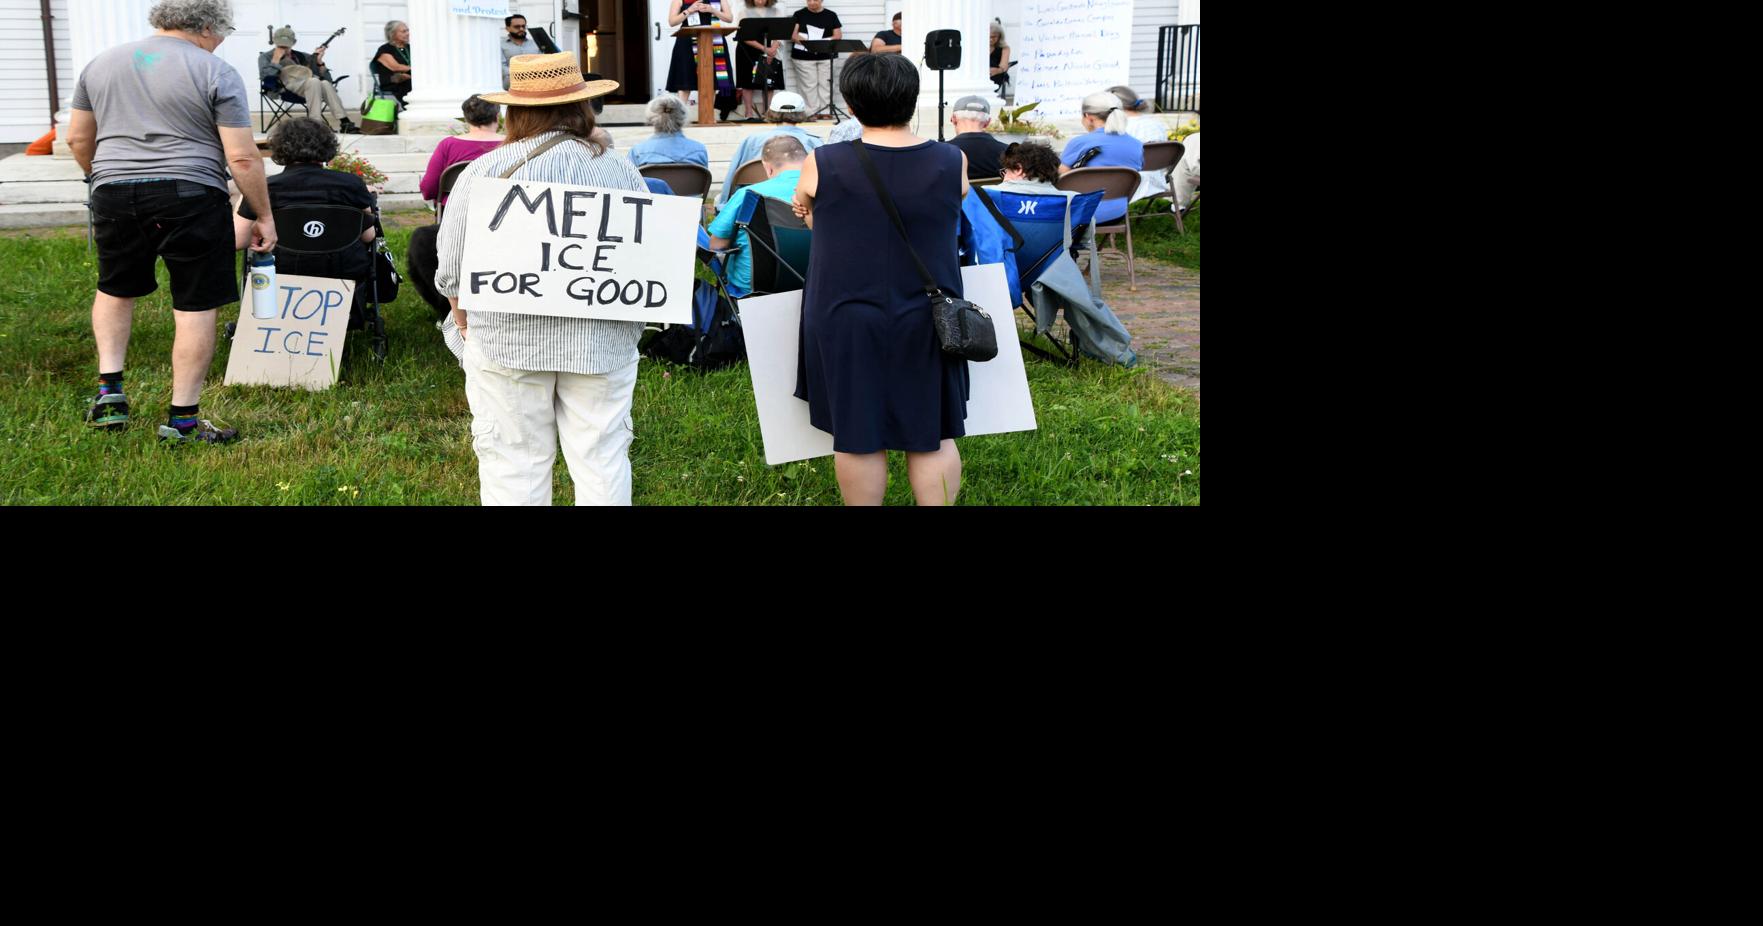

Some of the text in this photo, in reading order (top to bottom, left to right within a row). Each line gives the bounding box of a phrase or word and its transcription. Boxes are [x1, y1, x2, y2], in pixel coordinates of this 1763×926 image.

[472, 5, 507, 16] Protest
[488, 184, 653, 244] MELT
[280, 285, 343, 326] TOP
[470, 271, 668, 308] FOR GOOD
